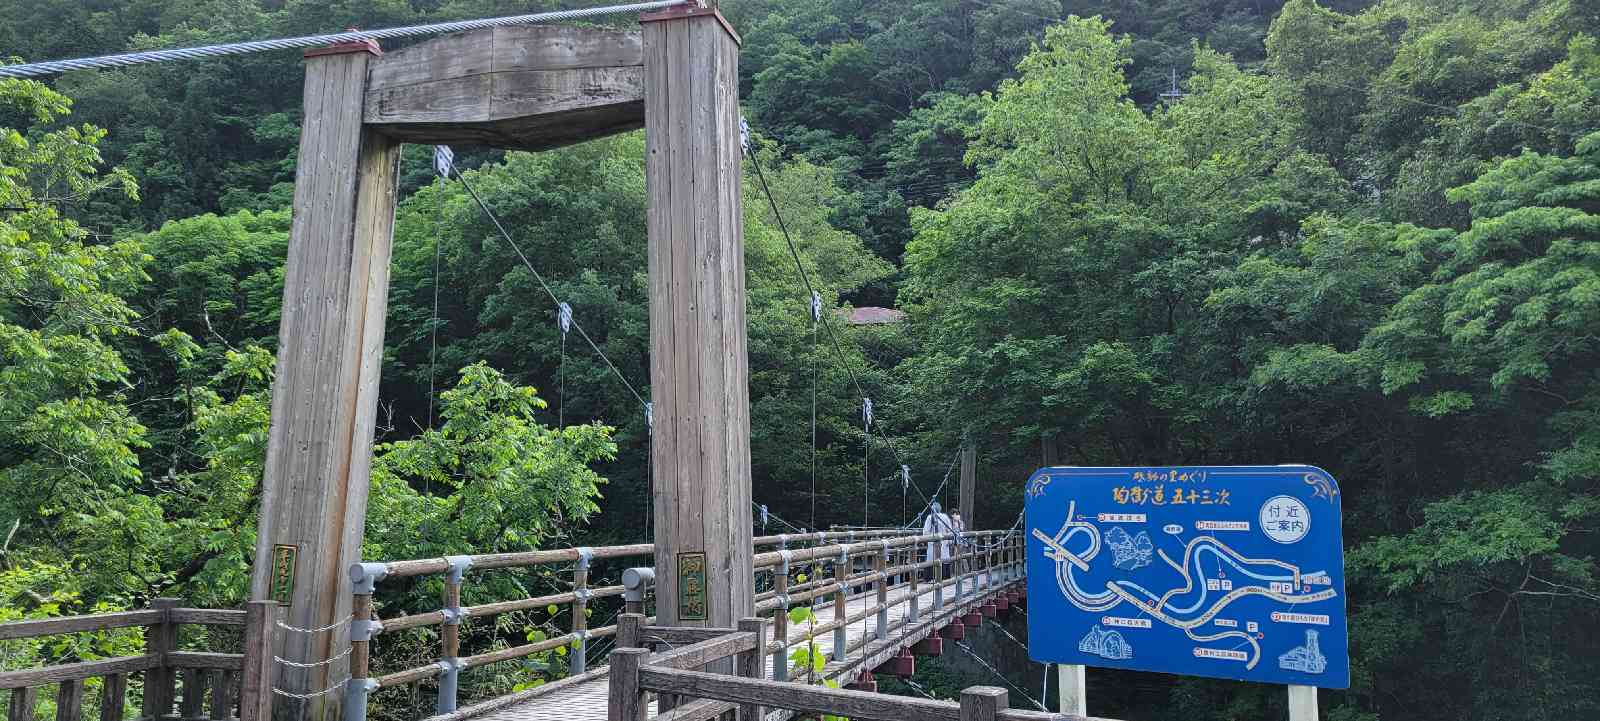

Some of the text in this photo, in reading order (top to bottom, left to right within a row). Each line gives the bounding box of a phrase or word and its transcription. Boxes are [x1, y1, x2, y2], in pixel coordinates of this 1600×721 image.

[1269, 505, 1299, 518] 付近
[1267, 520, 1304, 532] ご案内
